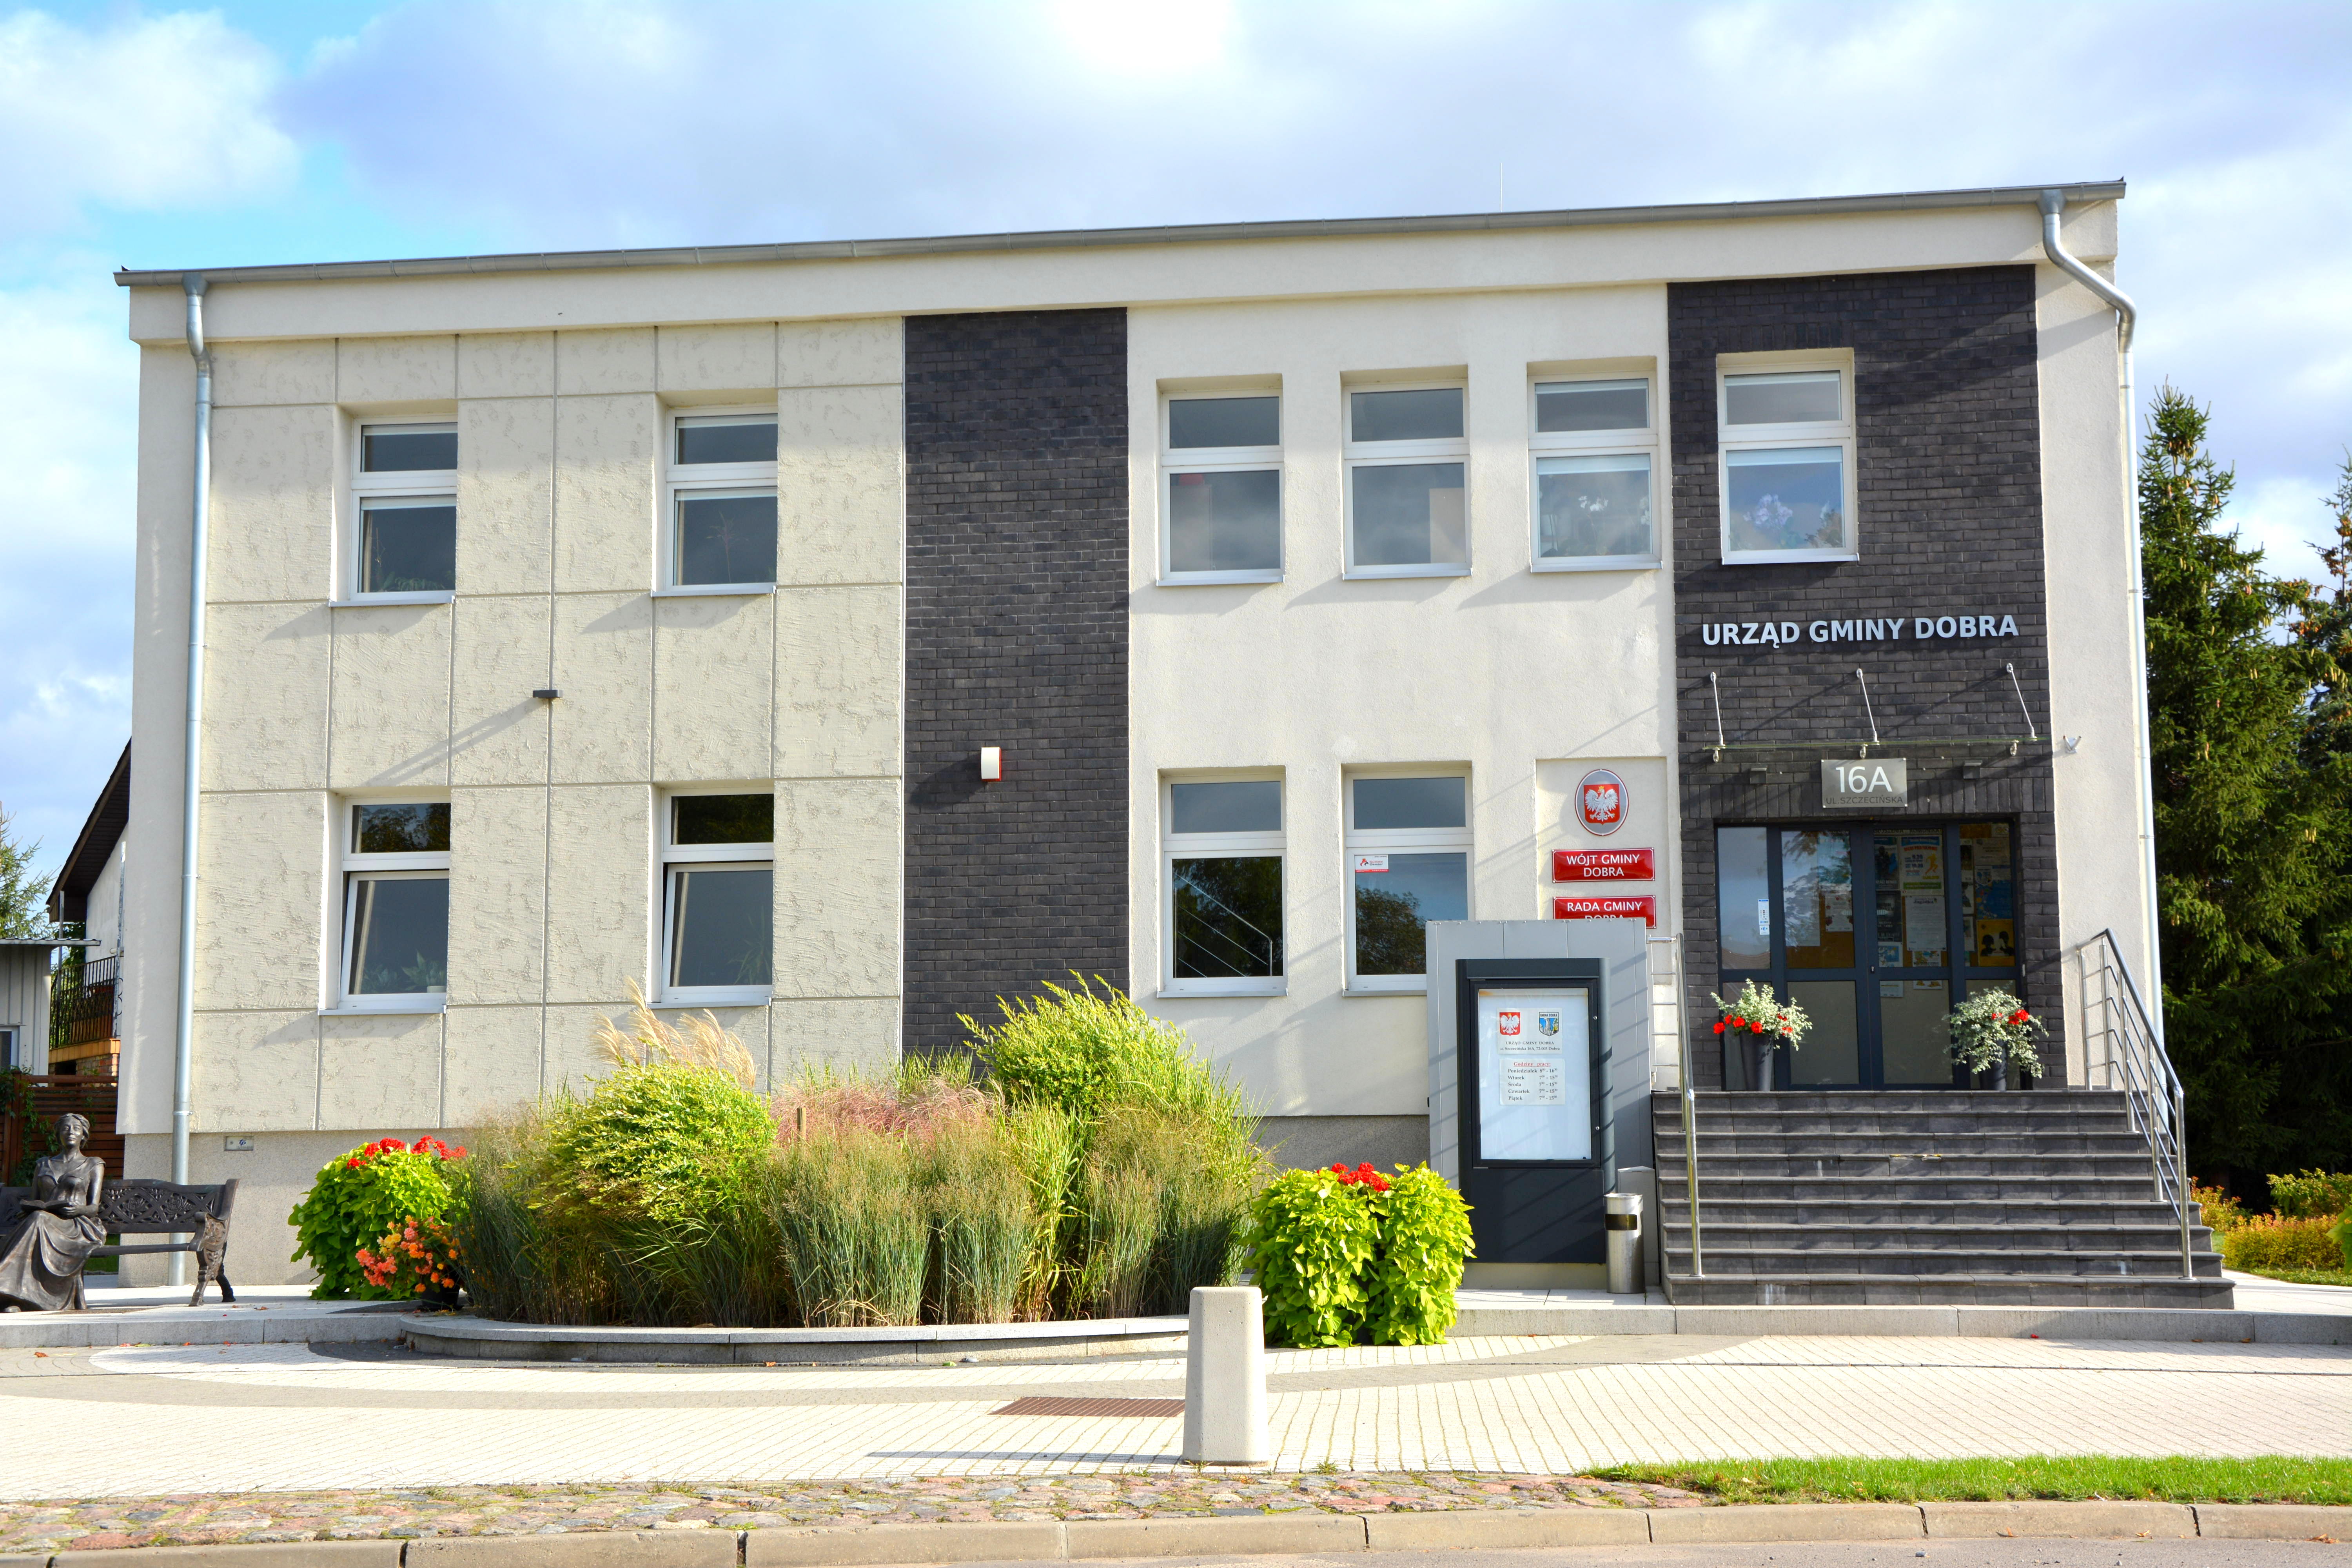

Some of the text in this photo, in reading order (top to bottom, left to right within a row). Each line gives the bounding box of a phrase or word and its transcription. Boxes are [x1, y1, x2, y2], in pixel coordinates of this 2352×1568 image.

[1703, 615, 2019, 649] URZĄD GMINY DOBRA
[1836, 766, 1893, 793] 16A
[1566, 853, 1640, 866] WÓJT GMINY
[1584, 867, 1624, 877] DOBRA
[1567, 902, 1642, 911] RADA GMINY
